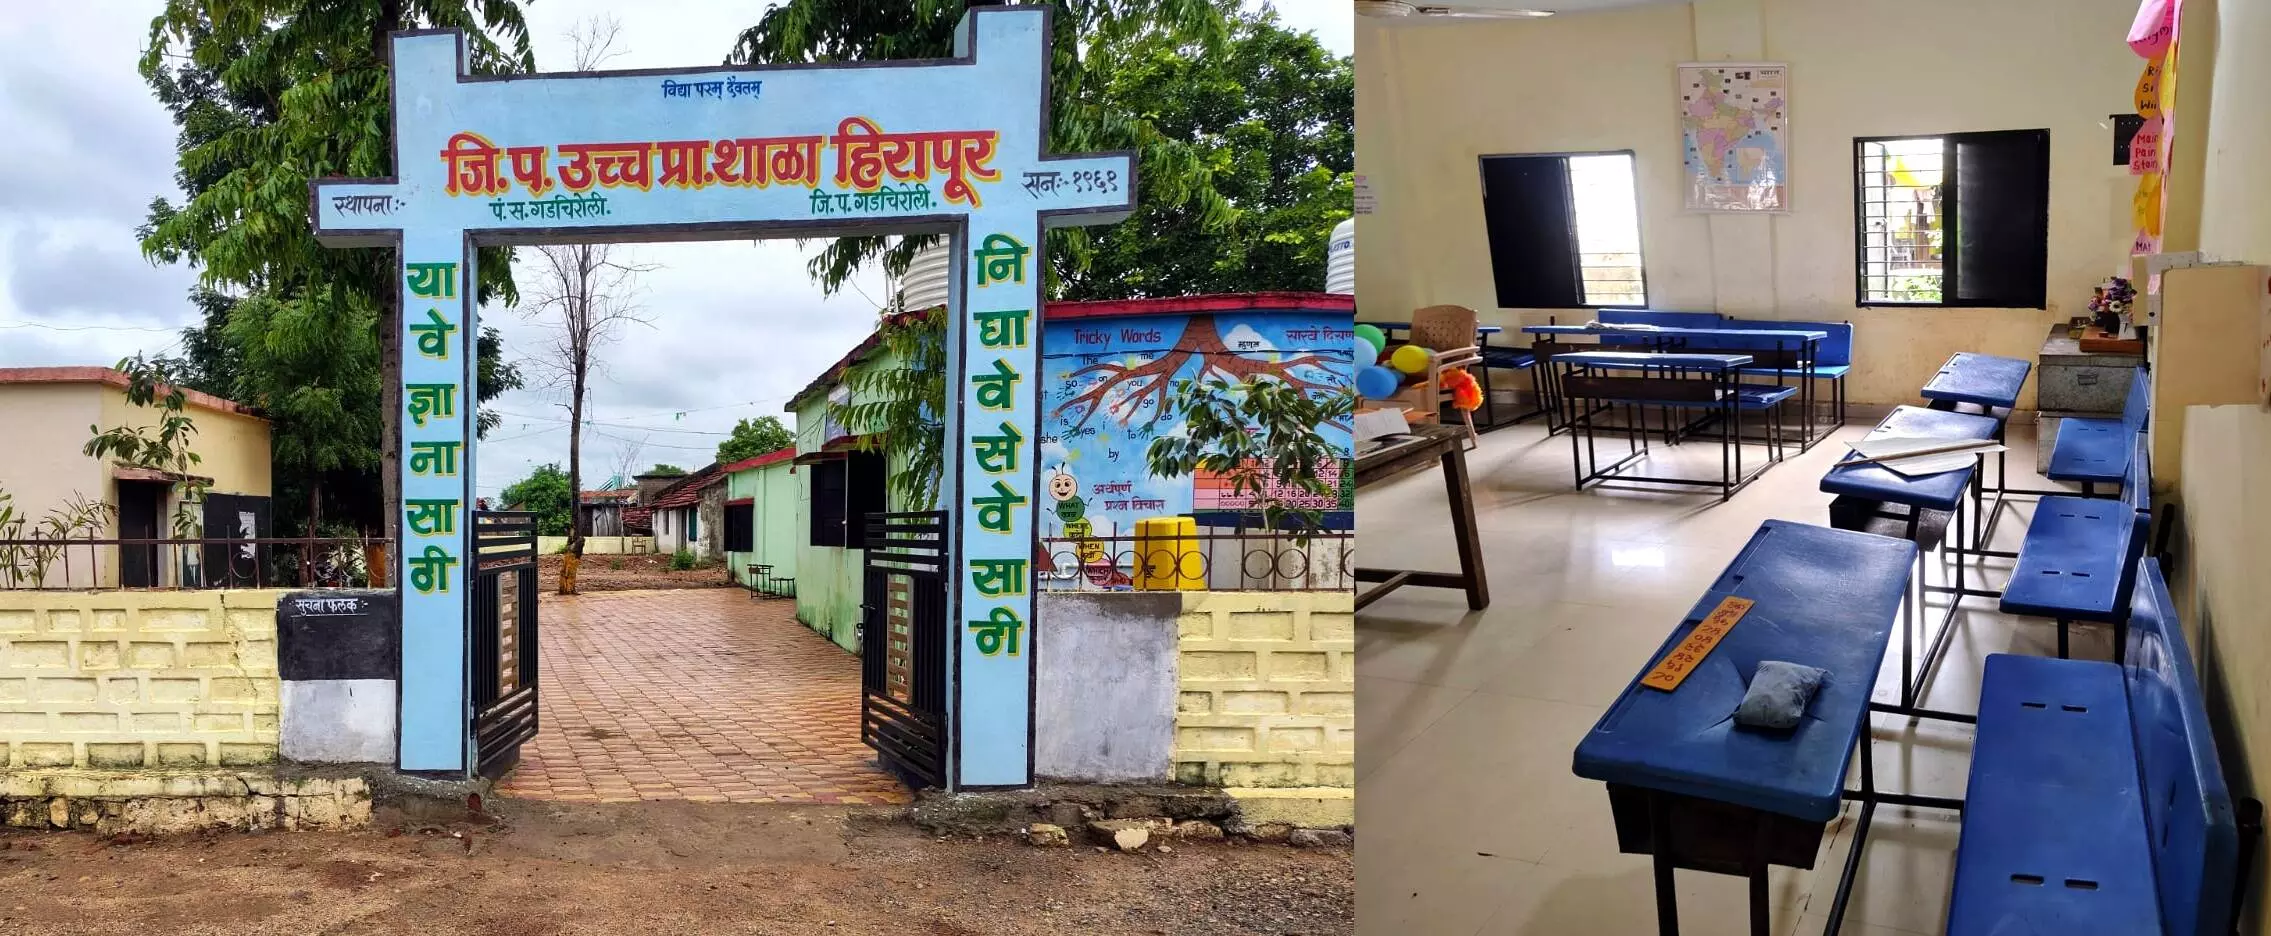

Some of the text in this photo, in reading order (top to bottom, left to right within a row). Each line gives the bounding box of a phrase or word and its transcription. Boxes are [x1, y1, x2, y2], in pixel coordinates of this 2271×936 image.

[661, 79, 692, 98] विद्या
[2136, 134, 2158, 145] Main
[2135, 148, 2156, 158] Pain
[556, 141, 652, 192] उच्च
[829, 116, 1001, 208] हिरापूर
[1073, 328, 1162, 350] Tricky Words
[1082, 354, 1098, 365] The
[1140, 352, 1153, 360] me
[1065, 380, 1078, 389] so
[1127, 380, 1142, 391] you
[1143, 399, 1154, 408] go
[1060, 416, 1069, 426] is
[1160, 412, 1173, 421] do
[1040, 432, 1058, 444] she
[1080, 428, 1096, 439] yes
[1127, 428, 1137, 440] to
[1108, 448, 1120, 461] by
[1275, 490, 1284, 498] 12
[1287, 490, 1297, 498] 16
[1299, 501, 1311, 509] 25
[1312, 500, 1324, 508] 30
[1326, 500, 1338, 508] 35
